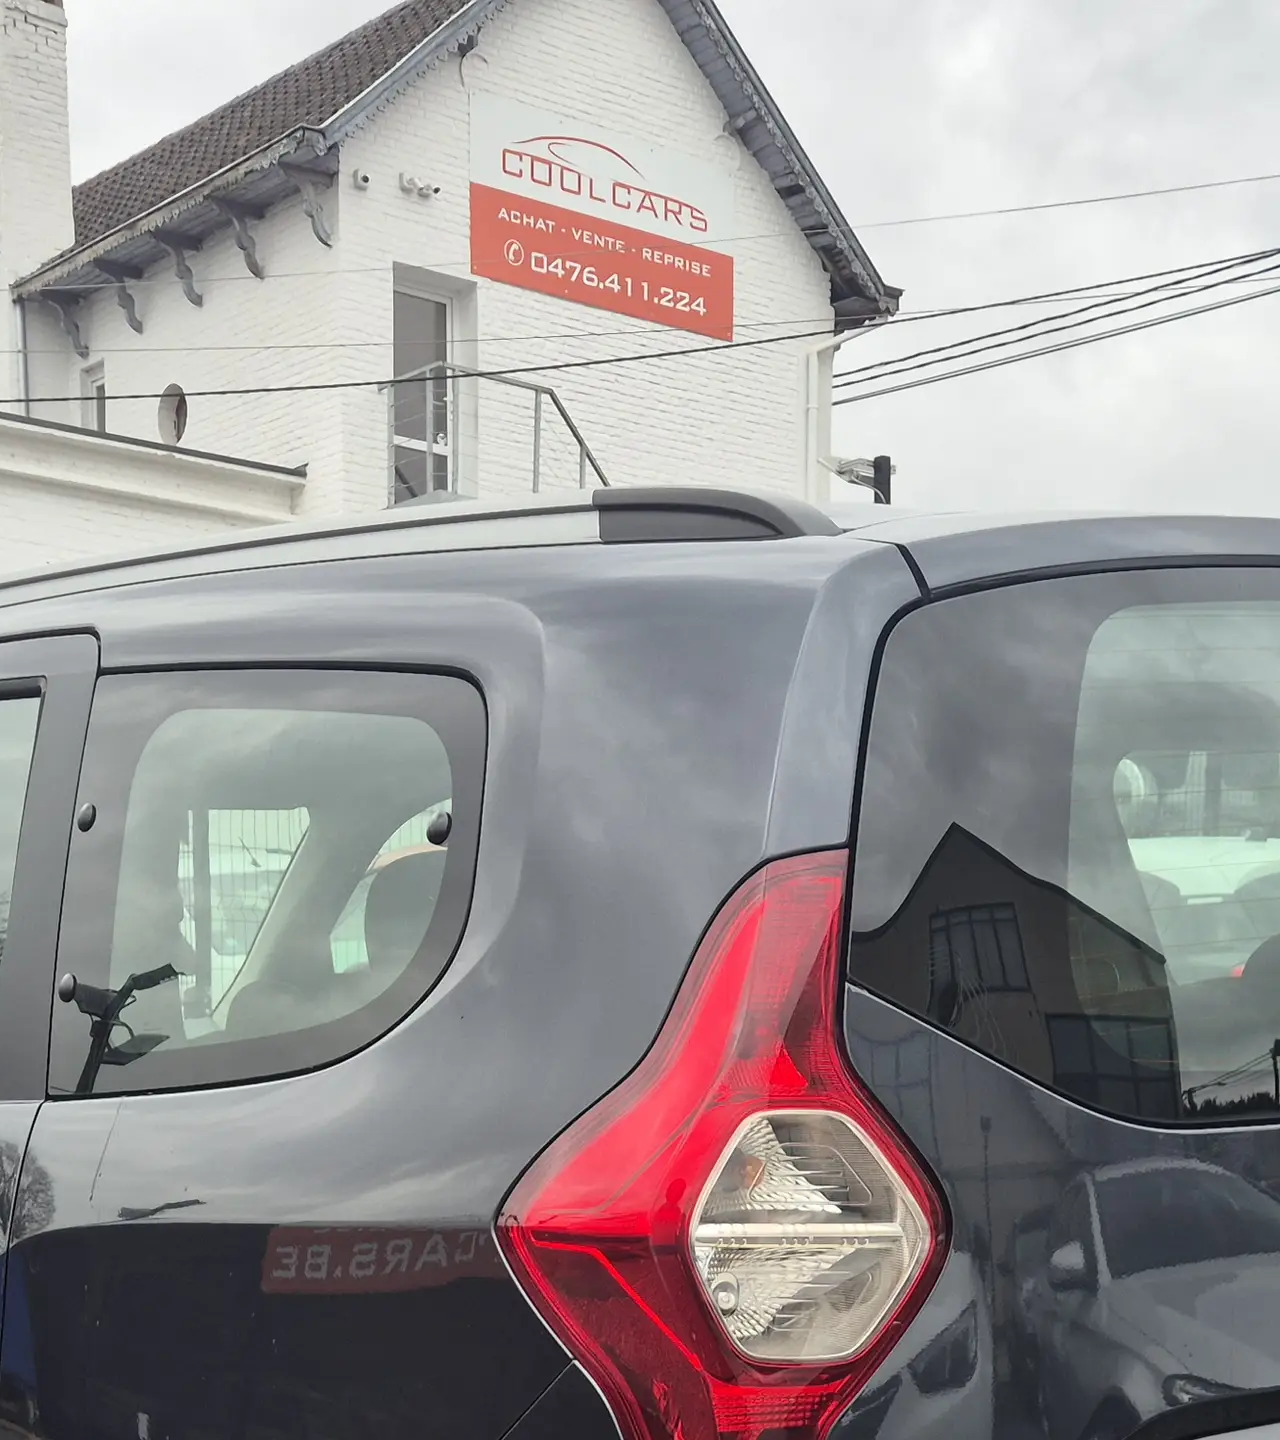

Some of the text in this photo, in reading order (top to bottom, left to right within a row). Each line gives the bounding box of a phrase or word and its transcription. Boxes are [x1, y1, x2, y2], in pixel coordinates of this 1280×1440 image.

[498, 207, 712, 277] ACHAT VENTE REPRISE
[531, 251, 707, 316] 0476.411.224
